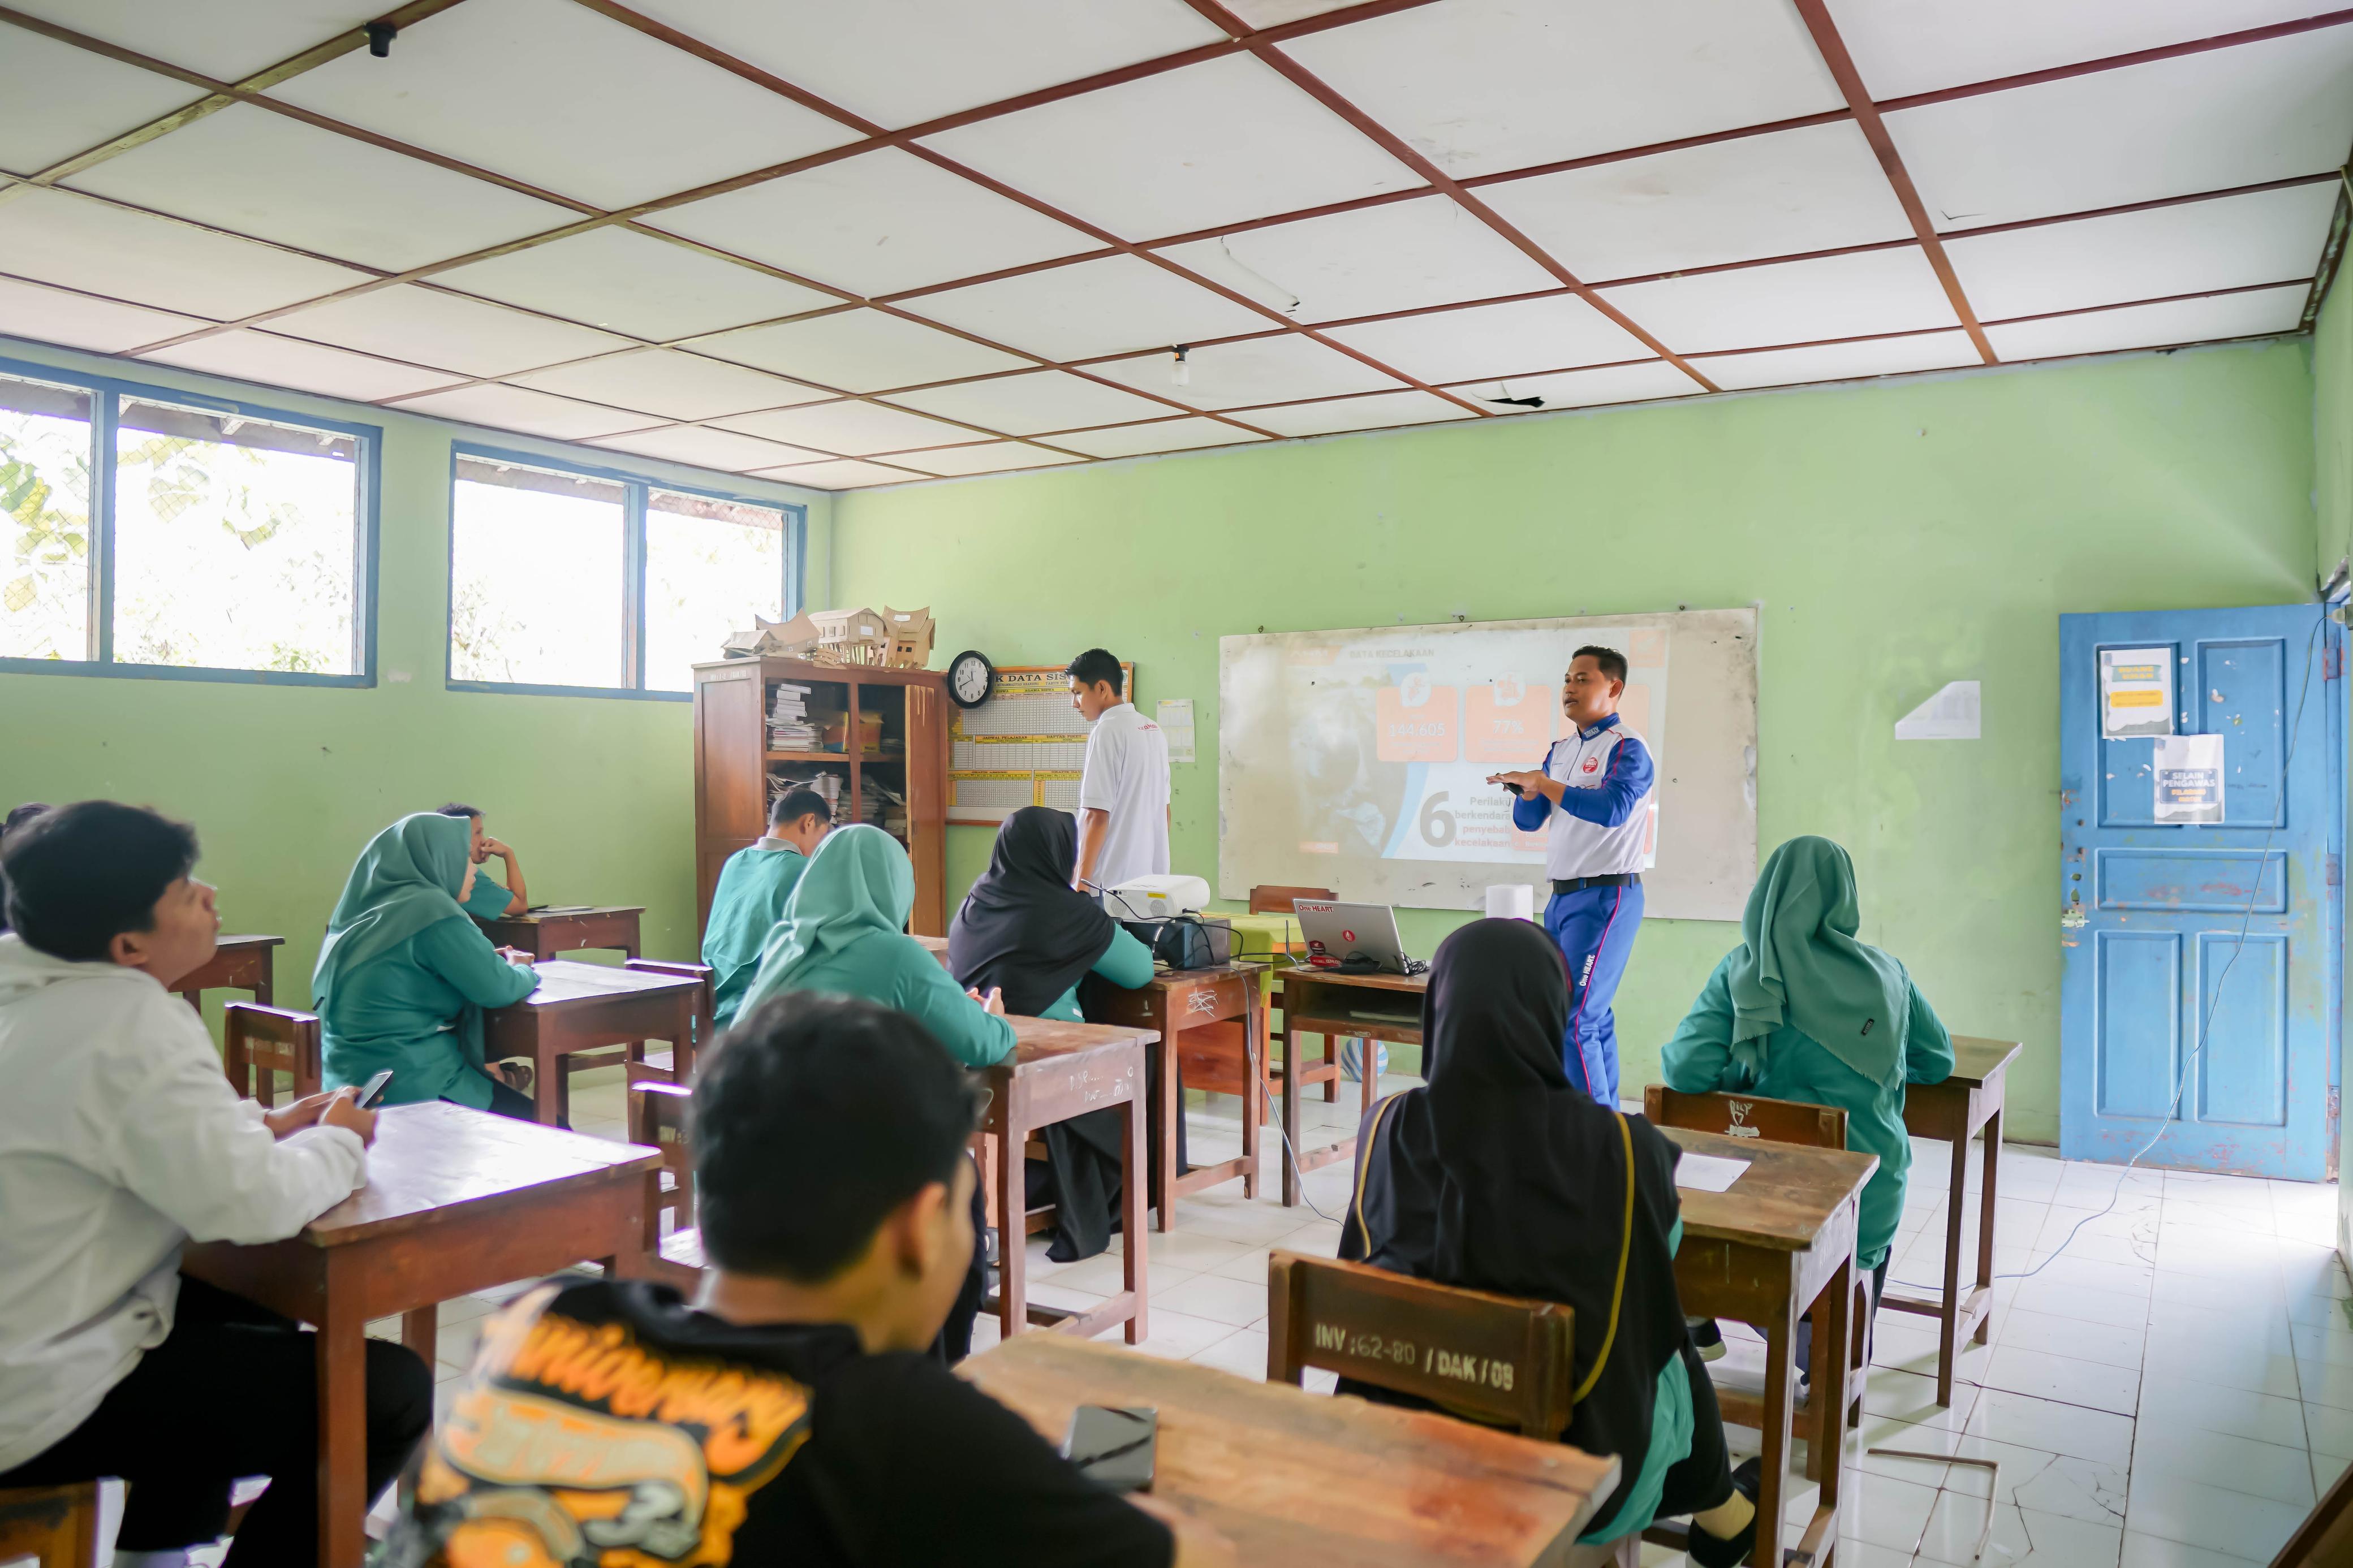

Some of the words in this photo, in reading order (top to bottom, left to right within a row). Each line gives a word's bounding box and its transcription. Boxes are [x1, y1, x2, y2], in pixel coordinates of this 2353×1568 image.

[1376, 649, 1434, 658] KECELAKAAN
[1389, 723, 1446, 737] 144.605
[1493, 719, 1524, 734] 77%
[2162, 779, 2216, 788] PENGAWAS
[1469, 796, 1511, 807] Perilaku
[1420, 791, 1457, 848] 6
[1455, 809, 1511, 820] berkendara
[1463, 824, 1511, 835] penyebab
[1454, 837, 1511, 848] kecelakaan
[1579, 974, 1589, 987] One
[1315, 1323, 1346, 1351] INV
